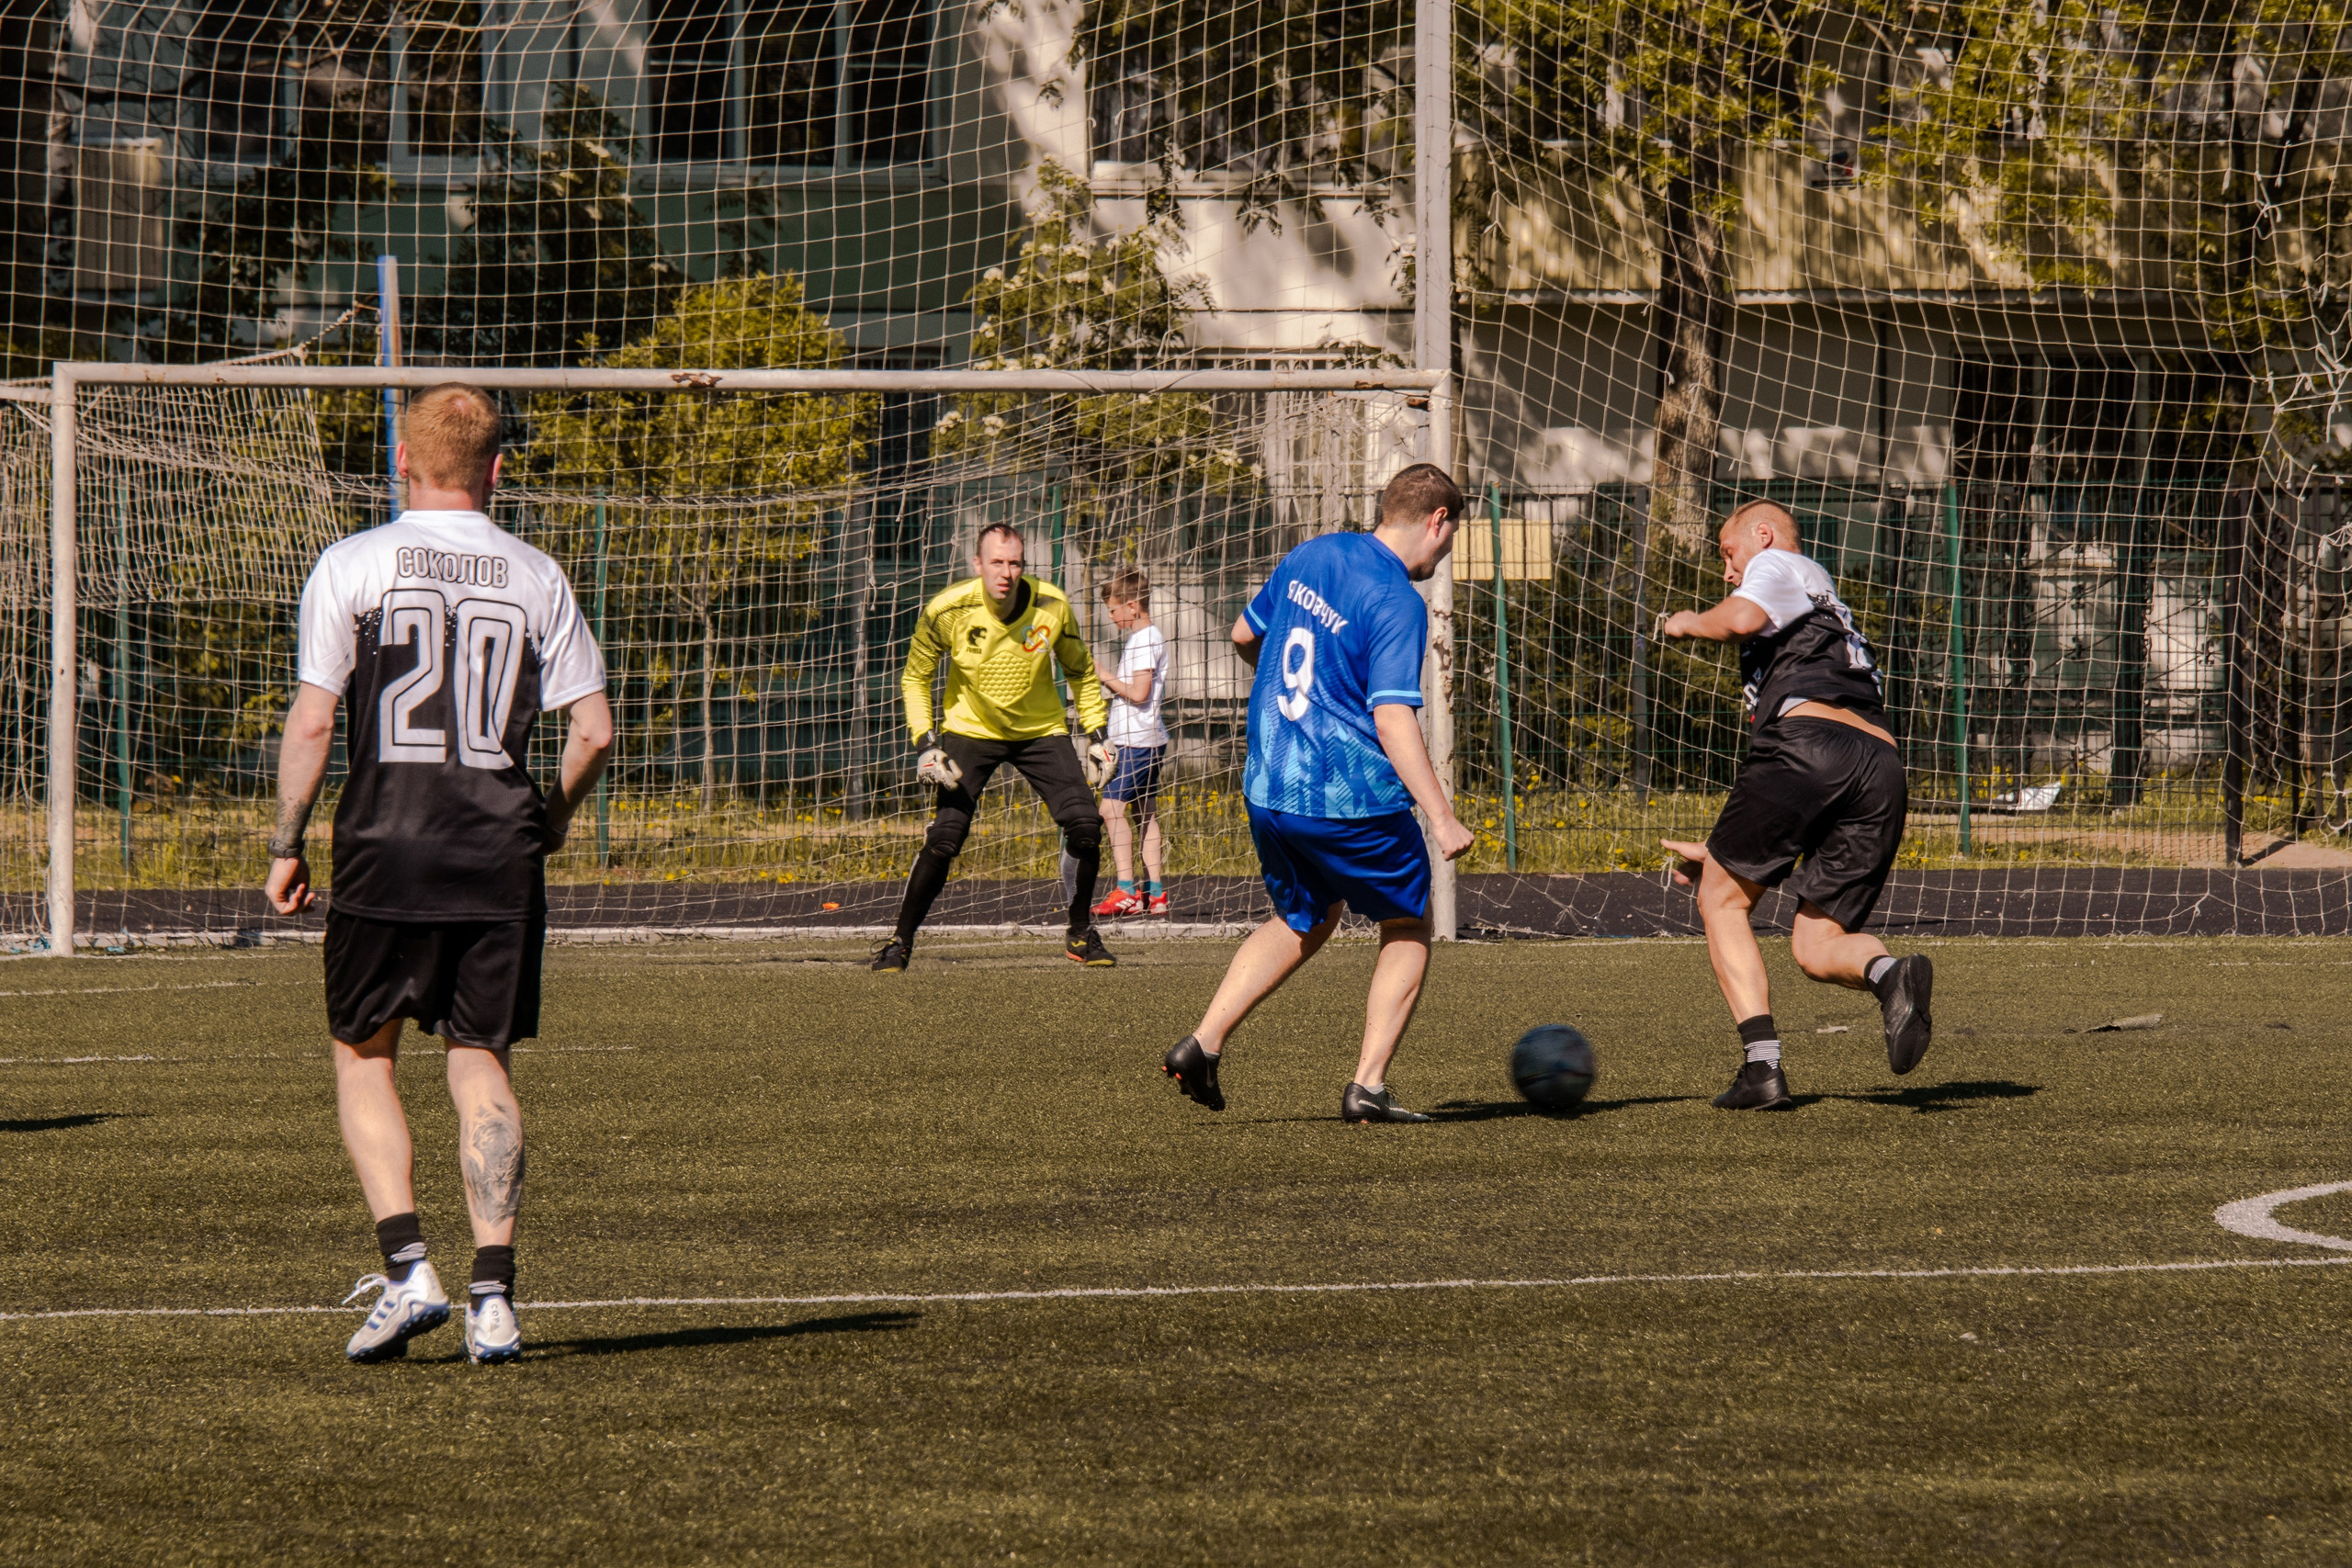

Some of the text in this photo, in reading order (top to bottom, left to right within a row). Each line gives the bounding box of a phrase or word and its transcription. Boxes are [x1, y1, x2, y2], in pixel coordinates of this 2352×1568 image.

[396, 547, 509, 589] СОКОЛОВ
[1286, 580, 1349, 635] ЯКОВЧУК
[379, 588, 527, 770] 20
[1276, 626, 1315, 722] 9
[492, 1303, 502, 1329] COPA
